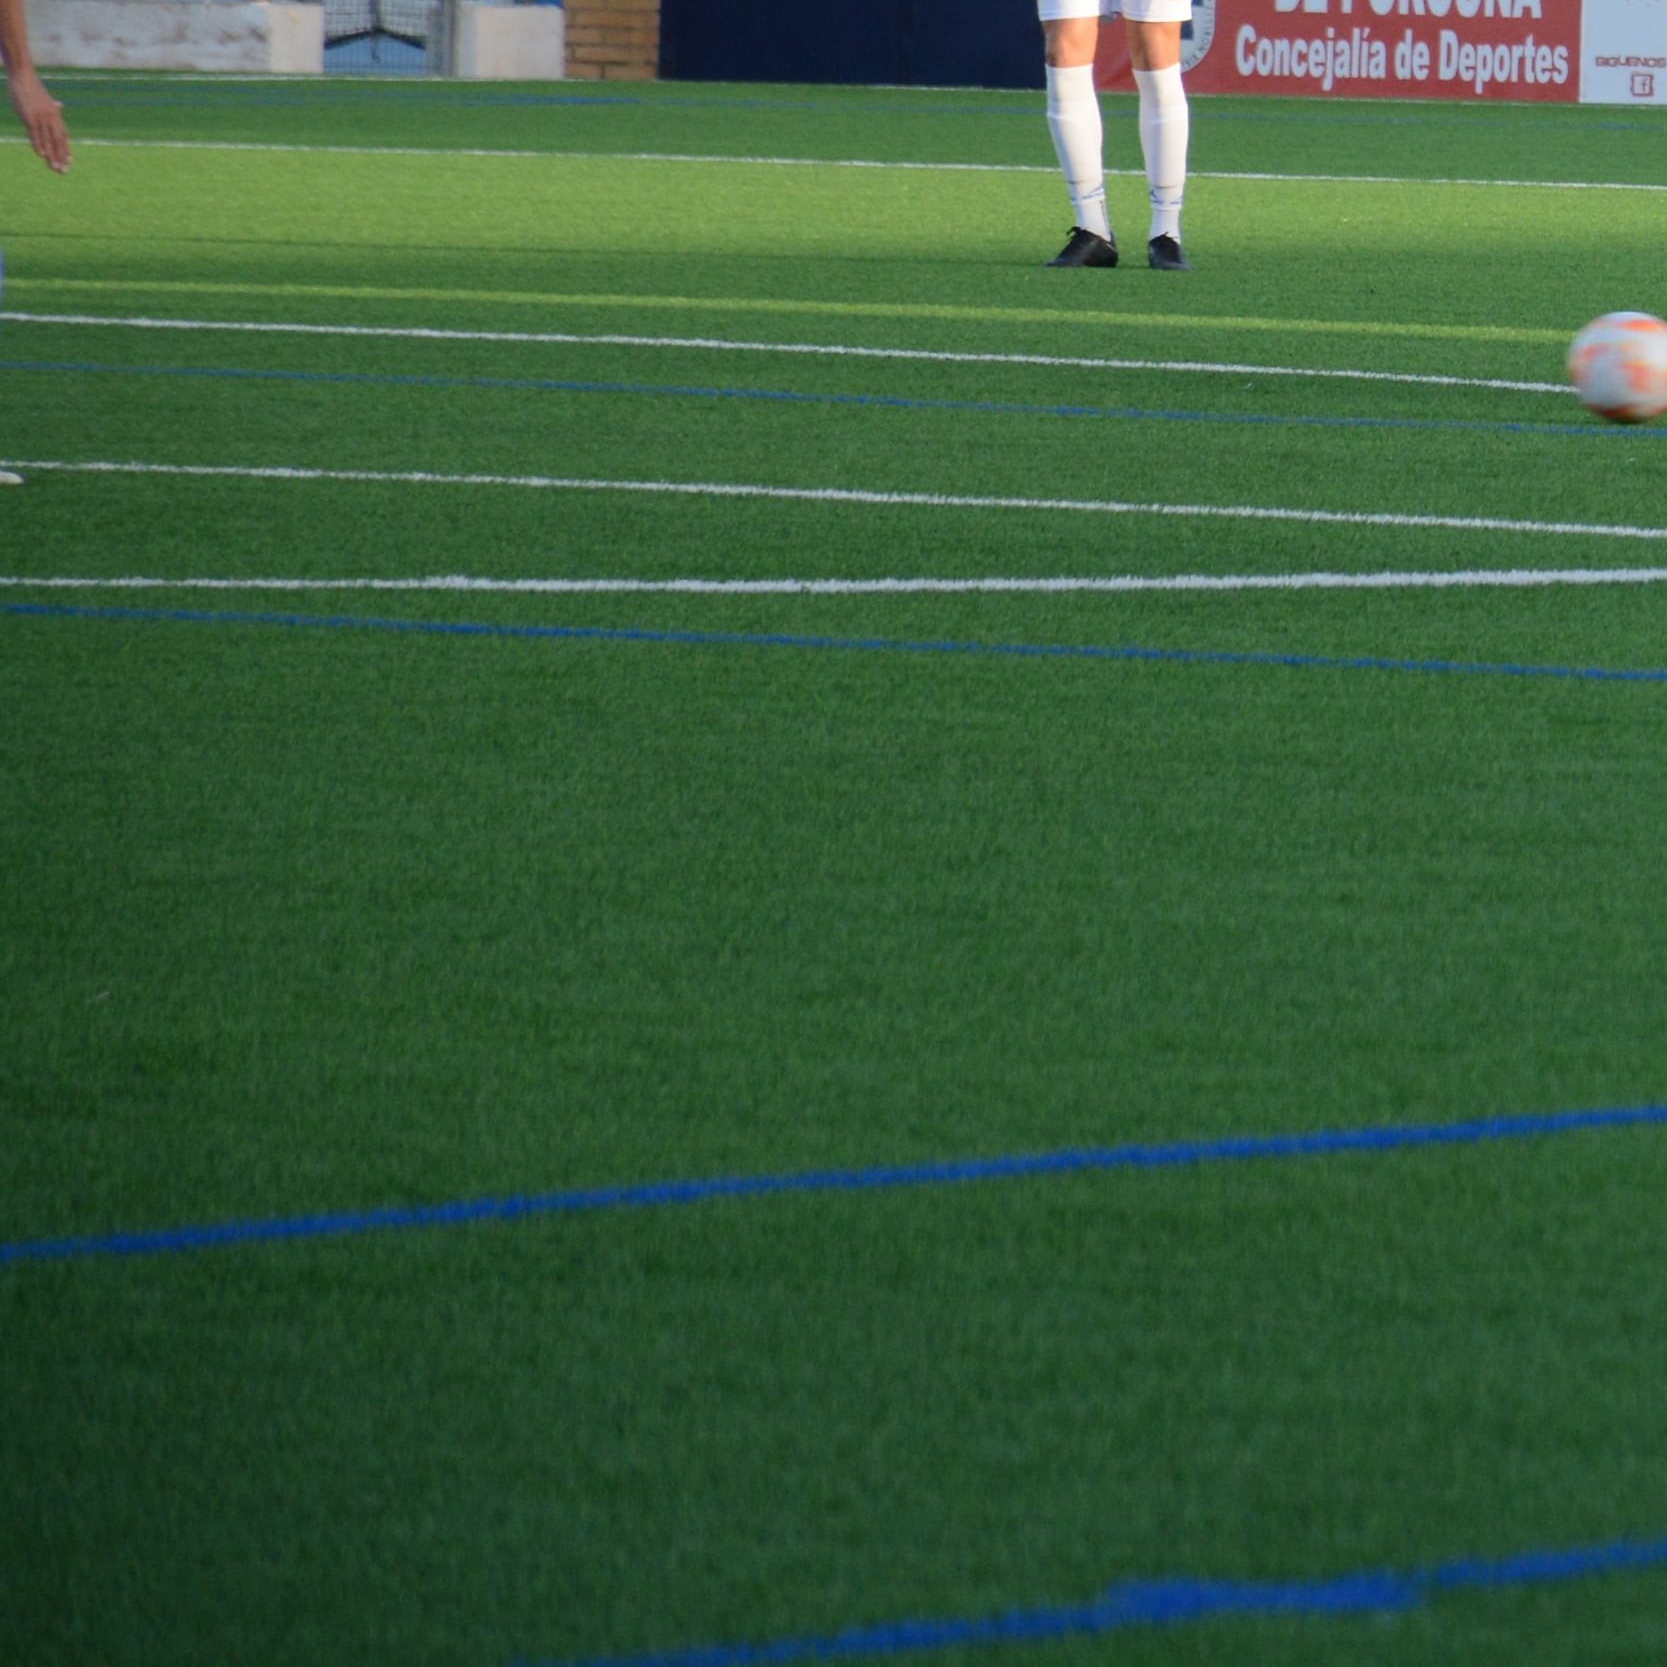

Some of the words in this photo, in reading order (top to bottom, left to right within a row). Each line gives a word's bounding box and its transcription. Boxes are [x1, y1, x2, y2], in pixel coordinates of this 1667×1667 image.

[1236, 24, 1387, 91] Concejalía
[1395, 29, 1430, 80] de
[1438, 30, 1569, 94] Deportes
